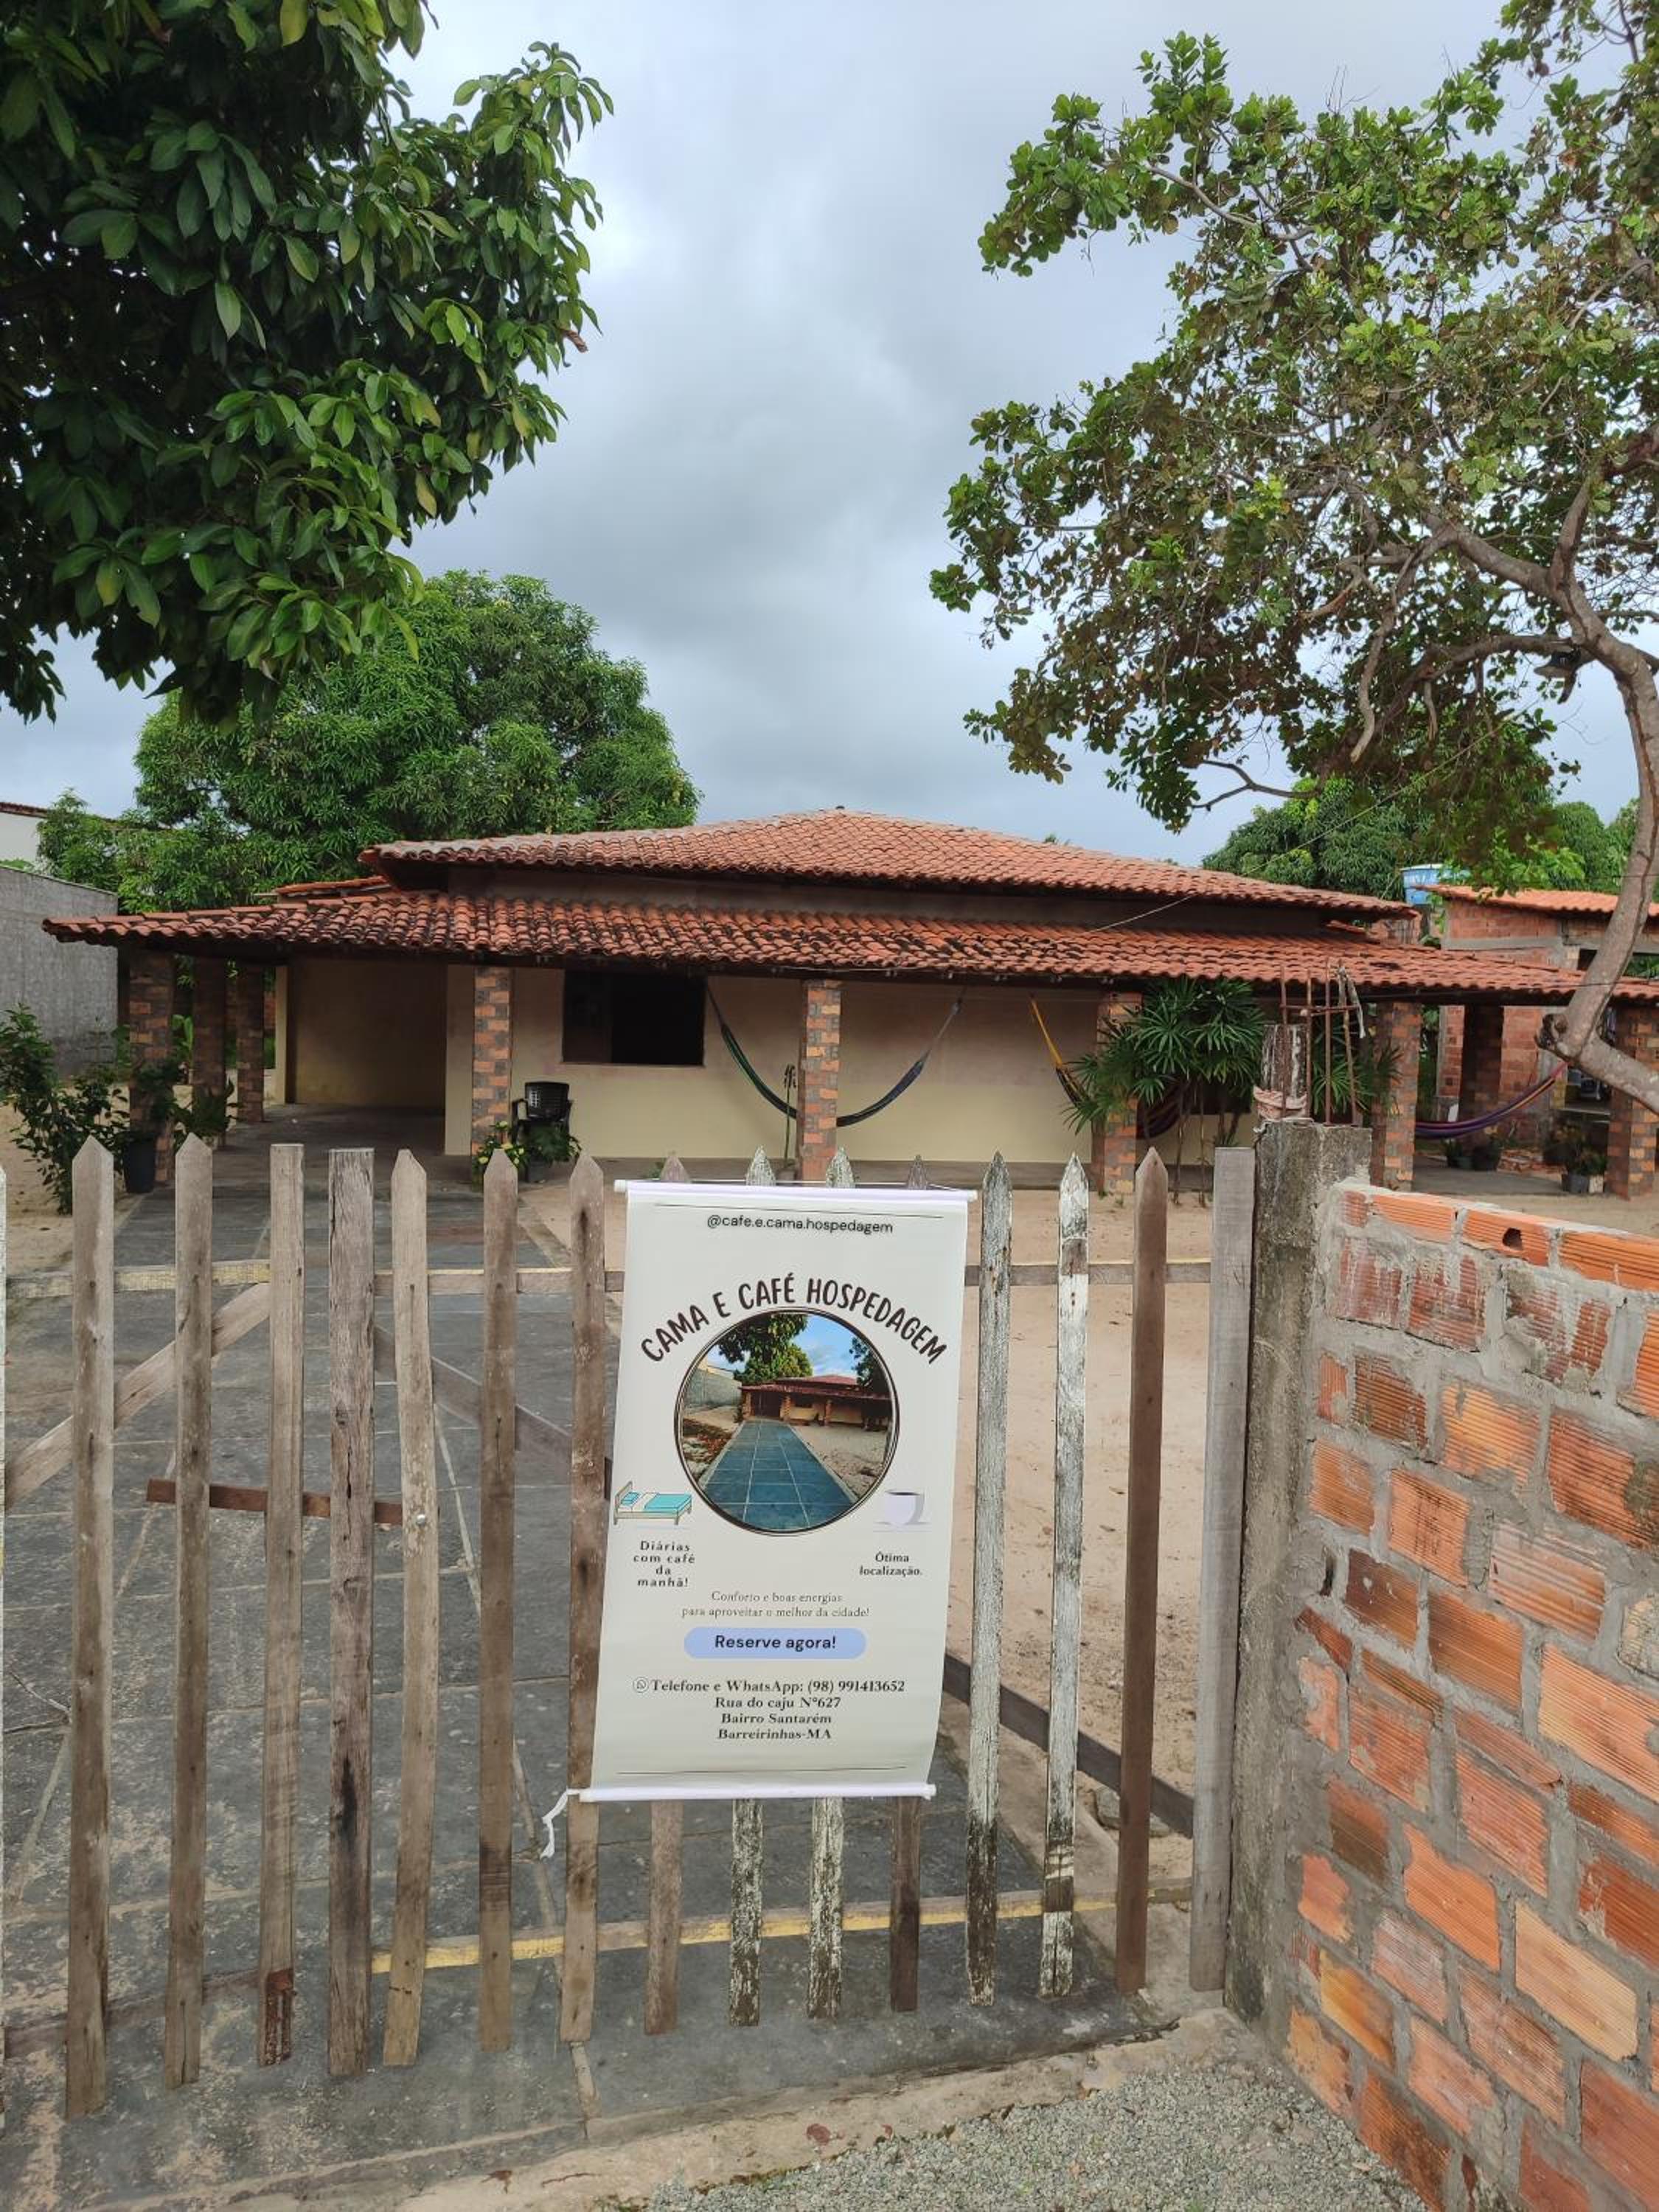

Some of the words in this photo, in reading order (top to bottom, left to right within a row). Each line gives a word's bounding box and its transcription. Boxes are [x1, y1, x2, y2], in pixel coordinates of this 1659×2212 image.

[707, 1214, 894, 1234] @cafe.e.cama.hospedagem
[641, 1304, 710, 1362] CAMA
[712, 1290, 731, 1318] E
[737, 1272, 796, 1310] CAFÉ
[806, 1277, 947, 1365] HOSPEDAGEM
[640, 1540, 690, 1551] Diárias
[633, 1554, 661, 1562] com
[667, 1553, 695, 1564] café
[874, 1551, 910, 1563] Ótima
[655, 1565, 672, 1575] da
[859, 1565, 923, 1577] localização.
[637, 1577, 689, 1587] manhã!
[712, 1591, 760, 1603] Conforto
[763, 1594, 769, 1602] e
[772, 1593, 796, 1603] boas
[799, 1593, 843, 1605] energias
[682, 1608, 706, 1618] para
[709, 1607, 763, 1618] aproveitar
[776, 1608, 813, 1618] melhor
[815, 1607, 829, 1618] da
[832, 1607, 870, 1618] cidade!
[714, 1635, 781, 1649] Reserve
[786, 1635, 836, 1653] agora!
[652, 1680, 709, 1692] Telefone
[713, 1683, 721, 1692] e
[726, 1680, 803, 1694] WhatsApp:
[807, 1679, 834, 1694] (98)
[838, 1680, 905, 1692] 991413652
[715, 1697, 742, 1708] Rua
[747, 1697, 763, 1708] do
[768, 1697, 795, 1711] caju
[721, 1714, 765, 1724] Bairro
[768, 1713, 832, 1724] Santarém
[717, 1728, 831, 1740] Barreirinhas-MA
